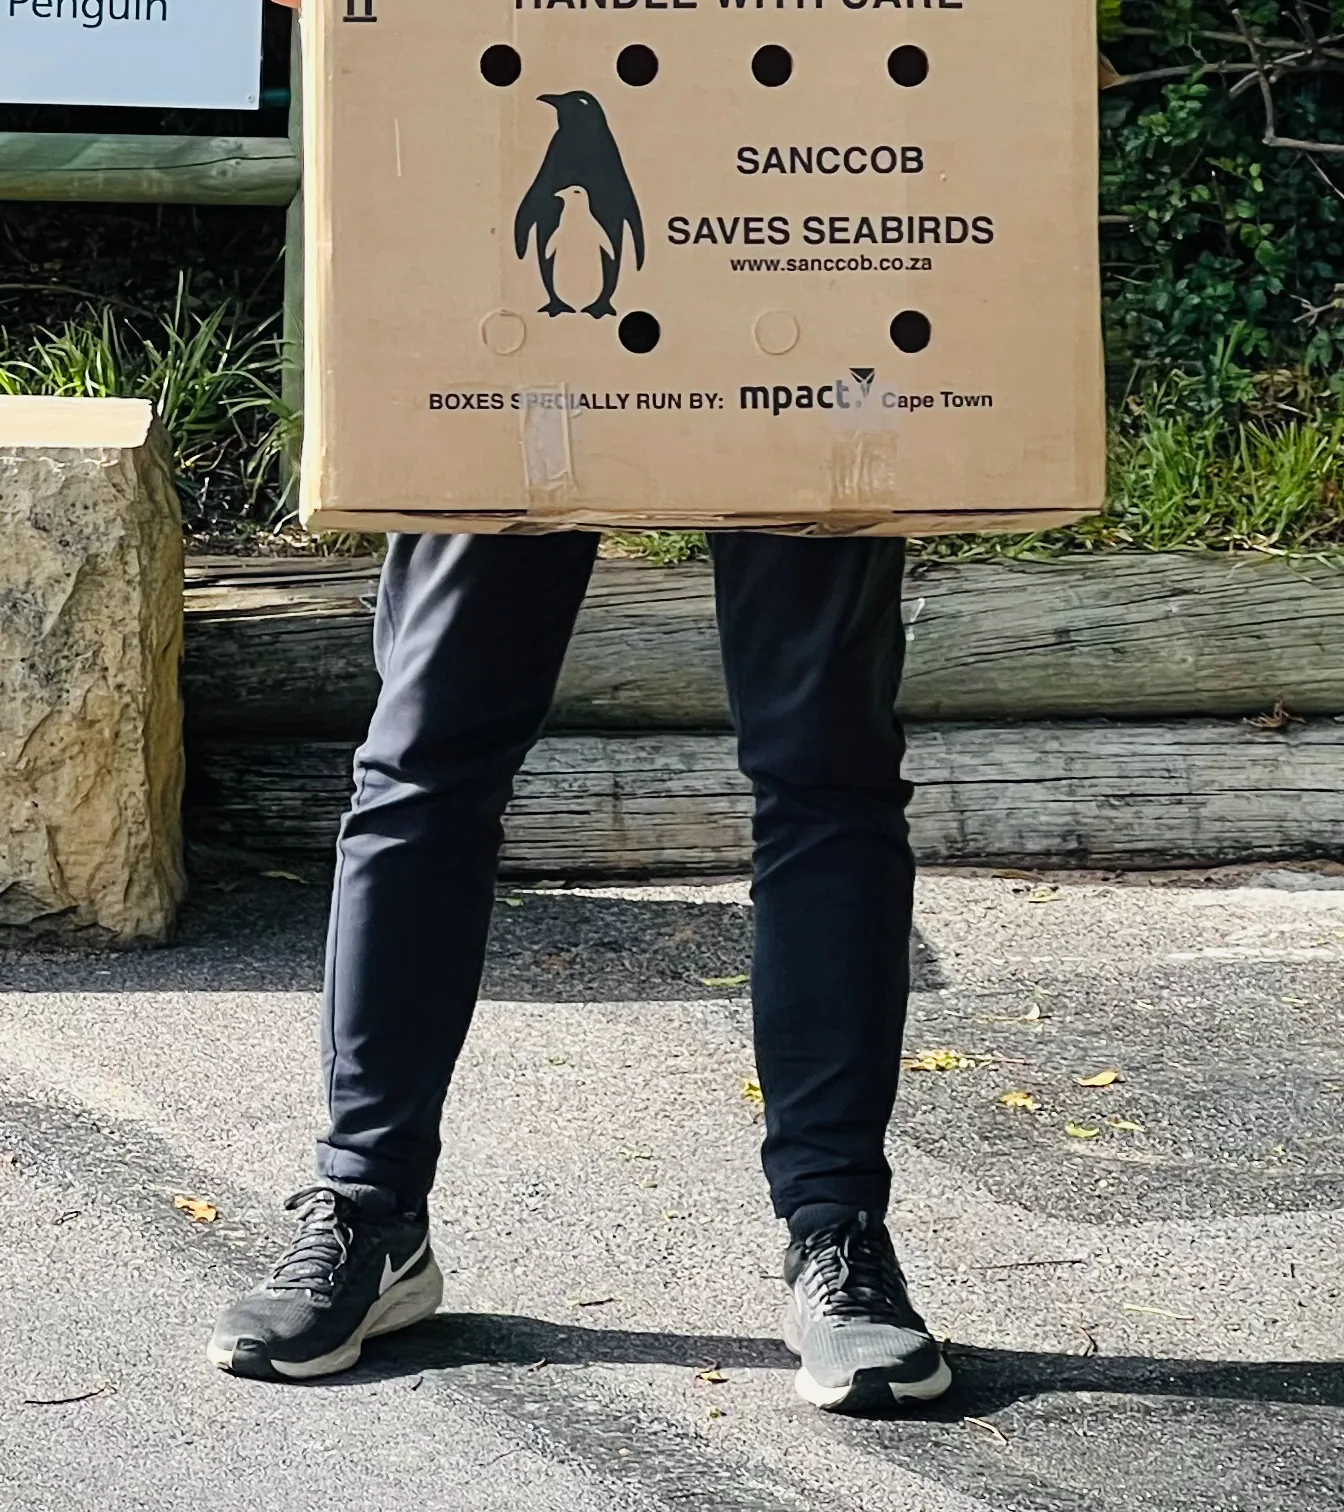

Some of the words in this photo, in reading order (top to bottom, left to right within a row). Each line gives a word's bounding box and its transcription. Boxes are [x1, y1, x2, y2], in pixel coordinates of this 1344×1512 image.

[736, 145, 924, 175] SANCCOB
[667, 215, 791, 246] SAVES
[802, 215, 994, 245] SEABIRDS
[730, 254, 933, 272] www.sanccob.co.za
[429, 392, 505, 410] BOXES
[510, 392, 630, 410] SPECIALLY
[636, 392, 682, 410] RUN
[689, 392, 724, 410] BY:
[882, 392, 935, 413] Cape
[939, 391, 993, 408] Town
